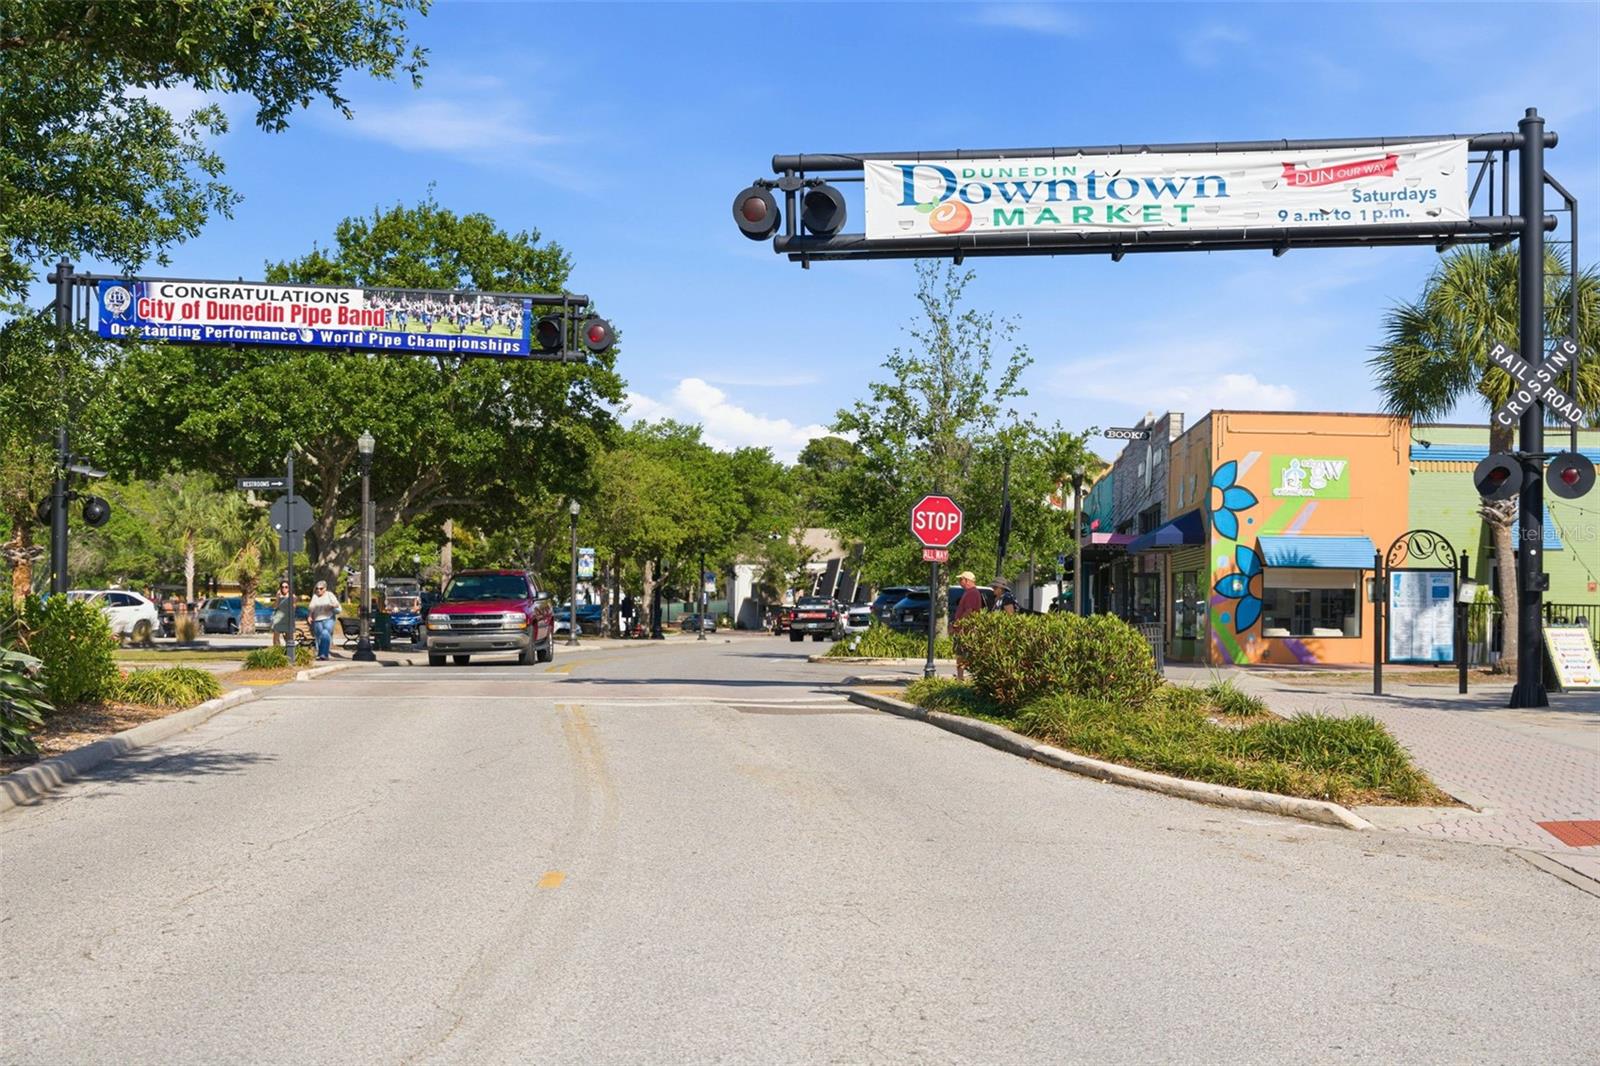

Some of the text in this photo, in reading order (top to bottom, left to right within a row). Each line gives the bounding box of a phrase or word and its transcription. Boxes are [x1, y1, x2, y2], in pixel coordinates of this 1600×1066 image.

[962, 166, 1078, 179] DUNEDIN
[1295, 163, 1387, 185] DUN OUR WAY
[893, 164, 1231, 207] Downtown
[1352, 186, 1437, 203] Saturdays
[992, 204, 1196, 227] MARKET
[1278, 210, 1288, 222] 9
[1334, 208, 1351, 221] to
[1360, 210, 1366, 221] 1
[1373, 207, 1410, 222] p.m.
[160, 284, 350, 304] CONGRATULATIONS
[137, 299, 174, 321] City
[182, 300, 200, 320] of
[206, 301, 284, 323] Dunedin
[290, 303, 331, 327] Pipe
[338, 306, 385, 327] Band
[110, 322, 520, 353] Ottanding Performance World Pipe Championships
[1490, 343, 1583, 422] RAIL ROAD
[1497, 340, 1577, 425] CROSSING
[915, 511, 958, 531] STOP
